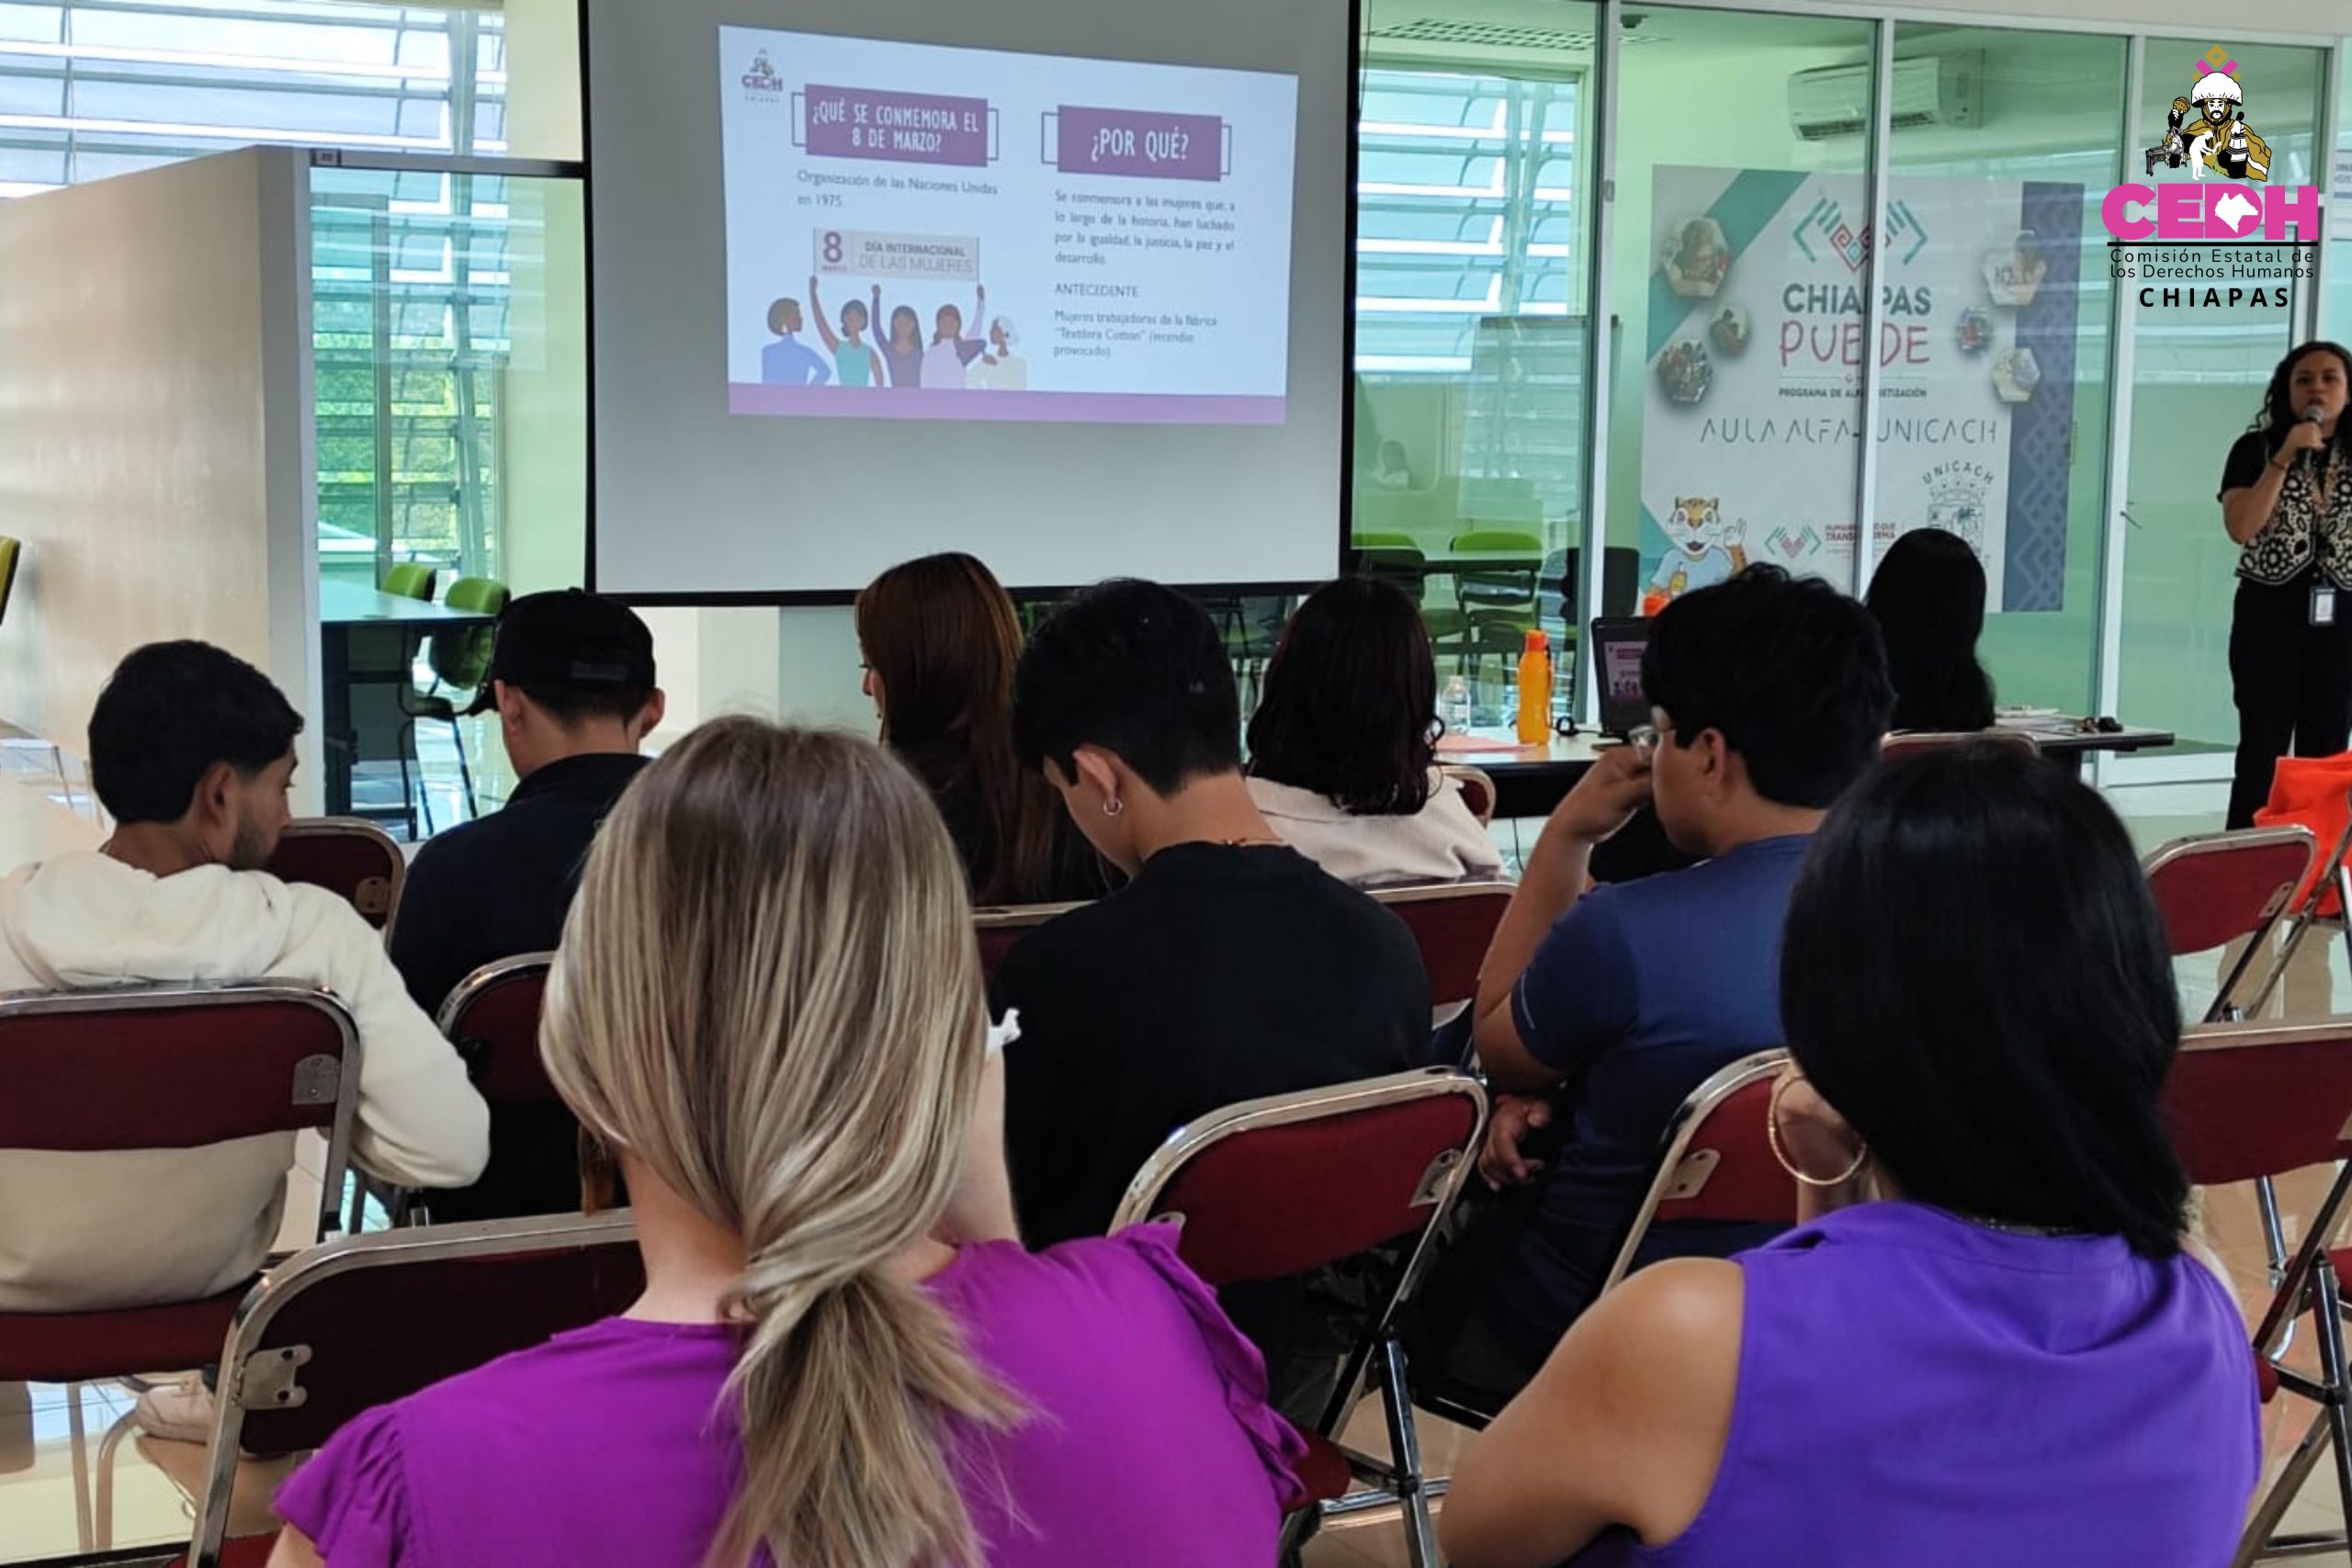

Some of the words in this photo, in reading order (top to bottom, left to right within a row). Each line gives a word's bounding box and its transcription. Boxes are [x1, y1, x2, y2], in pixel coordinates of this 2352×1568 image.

[812, 97, 845, 124] ¿QUÉ
[854, 103, 868, 124] SE
[876, 106, 956, 130] CONMEMORA
[964, 111, 979, 132] EL
[852, 129, 861, 146] 8
[868, 130, 886, 148] DE
[893, 132, 942, 152] MARZO?
[1091, 128, 1136, 163] ¿POR
[1145, 126, 1189, 163] QUÉ?
[797, 168, 869, 186] Organización
[873, 175, 888, 187] de
[891, 175, 905, 189] las
[909, 176, 957, 193] Naciones
[961, 180, 998, 195] Unidas
[797, 196, 811, 205] en
[815, 194, 842, 207] 1975
[1055, 189, 1068, 202] Se
[1071, 194, 1131, 206] conmemora
[1136, 197, 1142, 206] a
[1146, 195, 1159, 208] las
[1161, 197, 1202, 211] mujeres
[1070, 210, 1095, 227] largo
[1100, 212, 1113, 225] de
[1117, 212, 1127, 225] la
[1174, 216, 1193, 229] han
[1195, 217, 1235, 231] luchado
[822, 231, 843, 264] 8
[865, 241, 884, 253] DÍA
[886, 243, 967, 257] INTERNACIONAL
[1055, 232, 1073, 246] por
[1076, 231, 1086, 243] la
[1196, 240, 1214, 252] paz
[860, 254, 878, 268] DE
[880, 254, 907, 270] LAS
[910, 256, 973, 274] MUJERES
[1054, 282, 1138, 299] ANTECEDENTE
[1055, 310, 1094, 324] Mujeres
[1096, 310, 1158, 326] trabajadoras
[1159, 312, 1172, 325] de
[1175, 312, 1184, 325] la
[1778, 320, 1930, 368] PUEDE
[1778, 387, 1828, 398] PROGRAMA
[1829, 388, 1842, 398] DE
[1700, 417, 1776, 444] AULA
[1921, 459, 1995, 485] UNICACH
